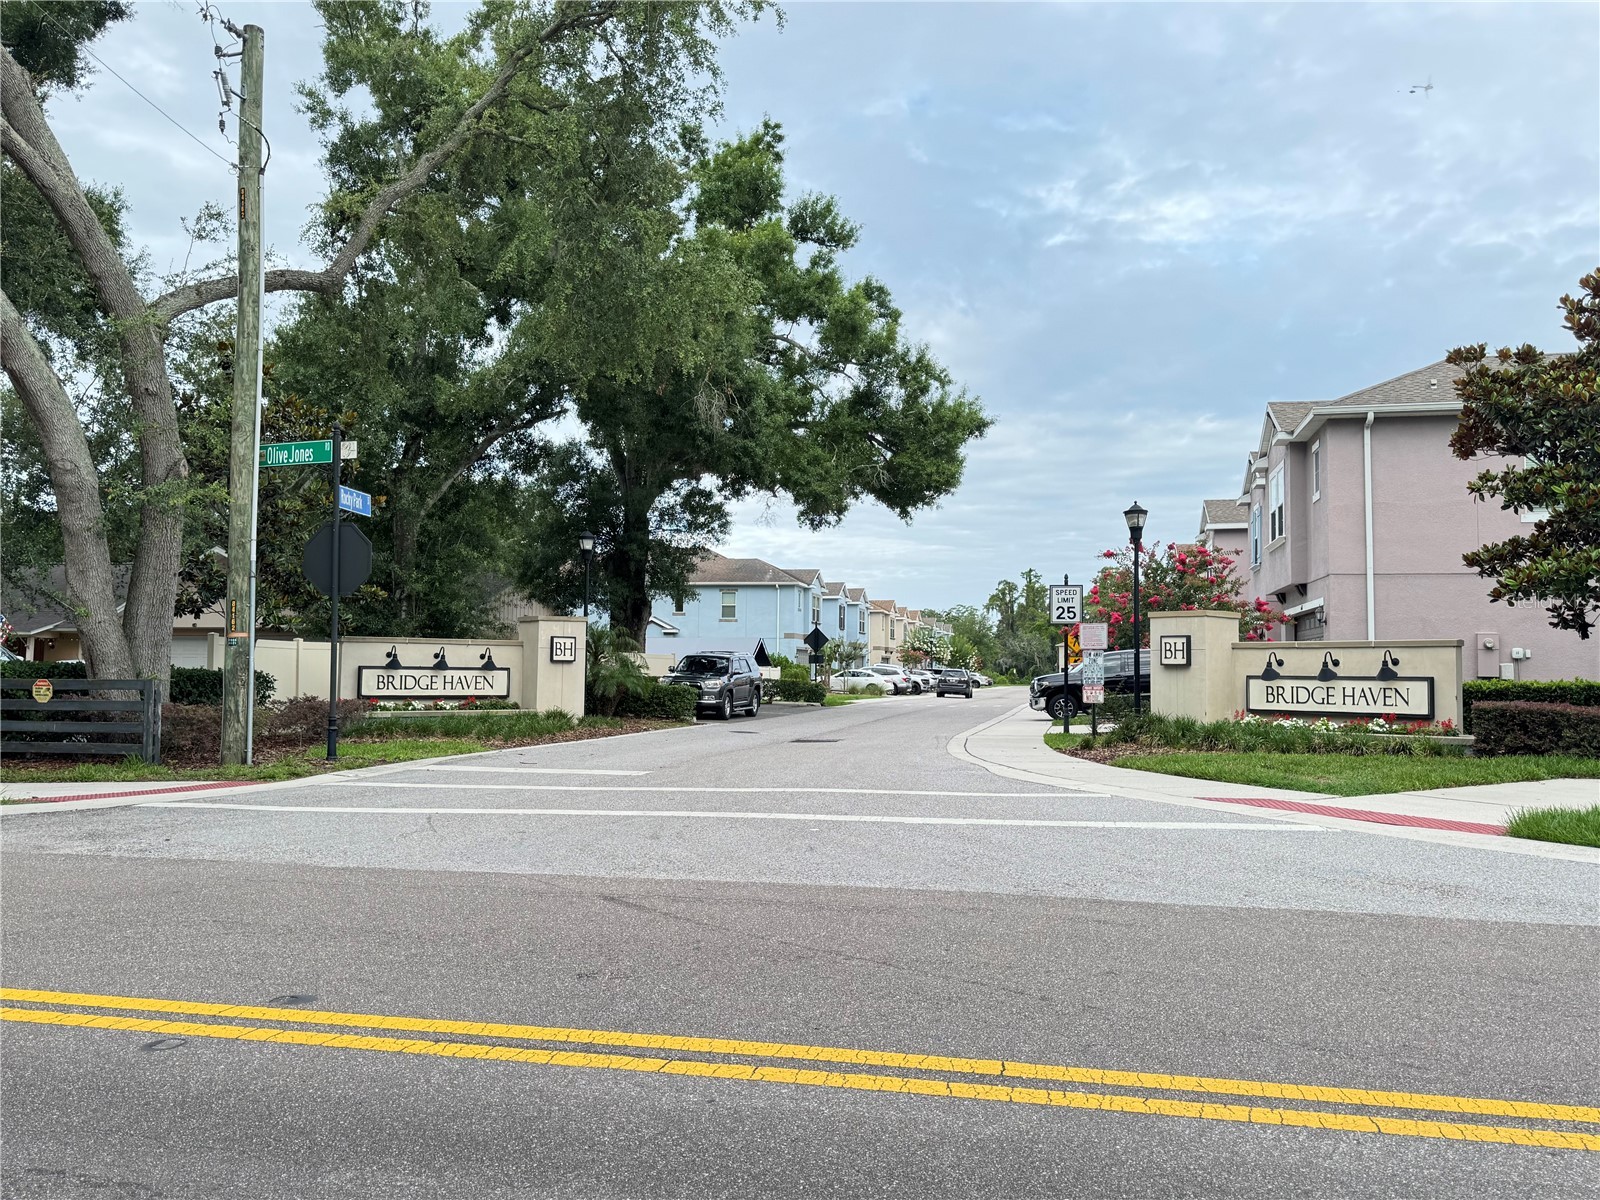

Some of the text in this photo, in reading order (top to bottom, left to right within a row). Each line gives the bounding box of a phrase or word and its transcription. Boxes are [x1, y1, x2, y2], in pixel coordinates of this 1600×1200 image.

[267, 446, 288, 464] Olive
[289, 445, 314, 463] Jones
[1056, 606, 1077, 620] 25
[554, 641, 573, 656] BH
[1163, 641, 1186, 659] BH
[376, 674, 494, 690] BRIDGE HAVEN
[1265, 685, 1410, 707] BRIDGE HAVEN
